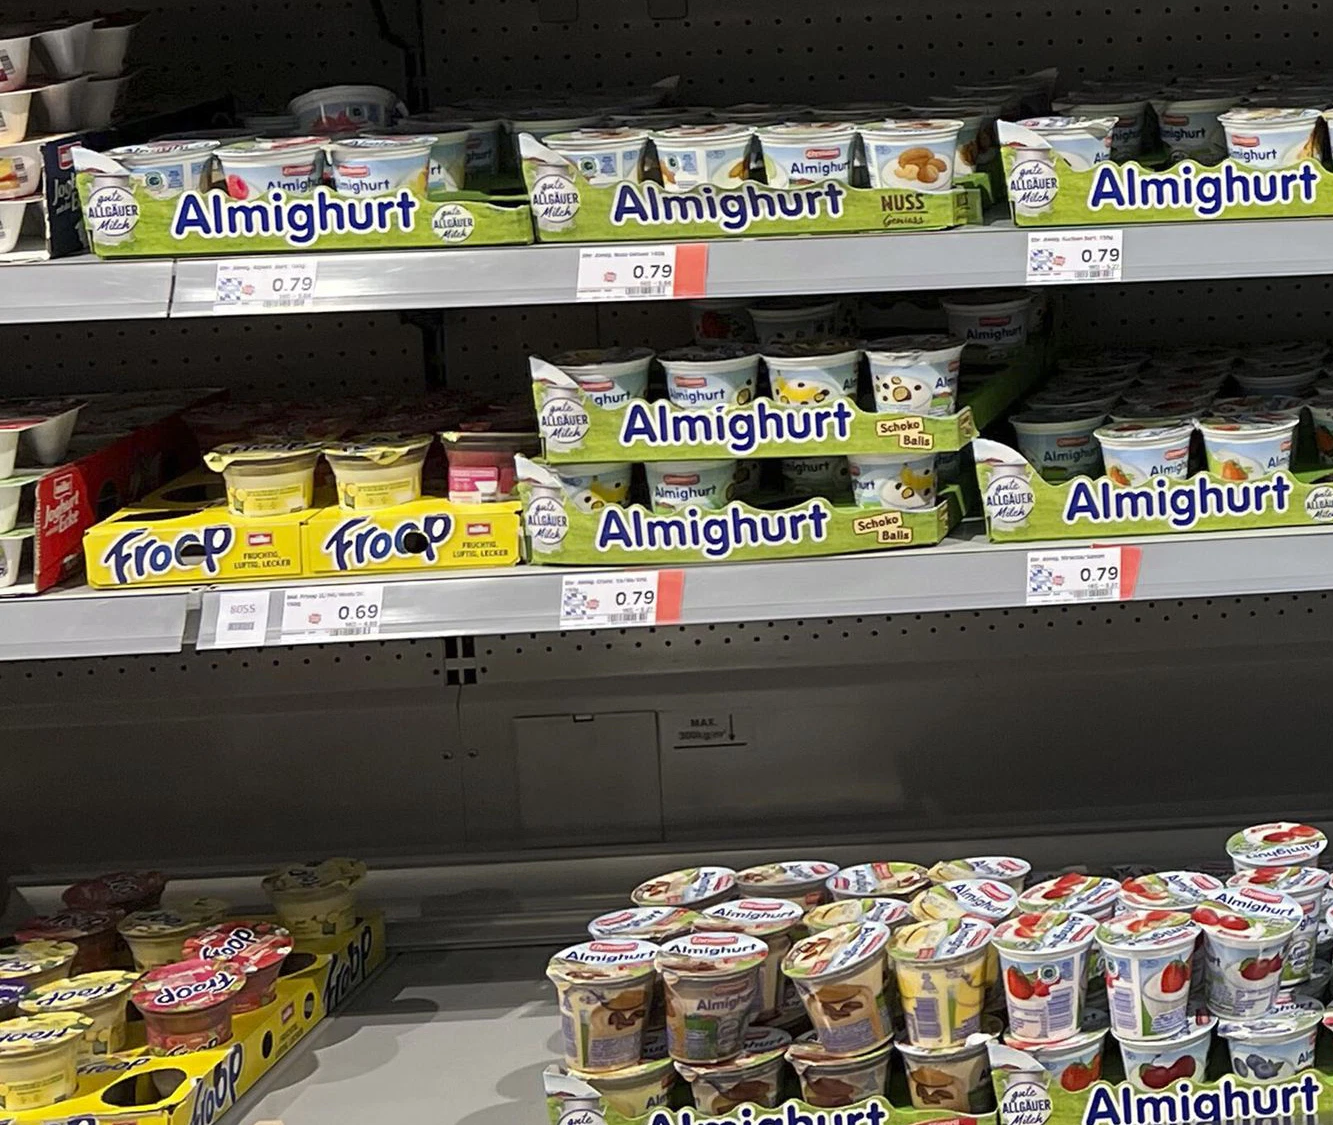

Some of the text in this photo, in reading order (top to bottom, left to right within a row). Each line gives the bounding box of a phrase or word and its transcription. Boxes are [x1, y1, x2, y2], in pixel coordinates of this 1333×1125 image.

[97, 187, 126, 204] gute
[1091, 164, 1317, 214] Almighurt
[613, 184, 844, 228] Almighurt
[881, 193, 926, 212] NUSS
[88, 203, 140, 220] ALLGÄUER
[175, 193, 417, 243] Almighurt
[97, 219, 131, 235] Milch
[1080, 248, 1120, 264] 0.79
[633, 264, 673, 280] 0.79
[272, 276, 313, 292] 0.79
[624, 401, 852, 453] Almighurt
[880, 421, 920, 434] Schoko
[902, 434, 930, 448] Balls
[1067, 478, 1292, 526] Almighurt
[600, 504, 827, 556] Almighurt
[857, 515, 899, 532] Schoko
[881, 529, 910, 542] Balls
[337, 604, 379, 622] 0.69
[156, 972, 238, 1007] Froop
[1002, 1099, 1052, 1115] ALLGÄUER
